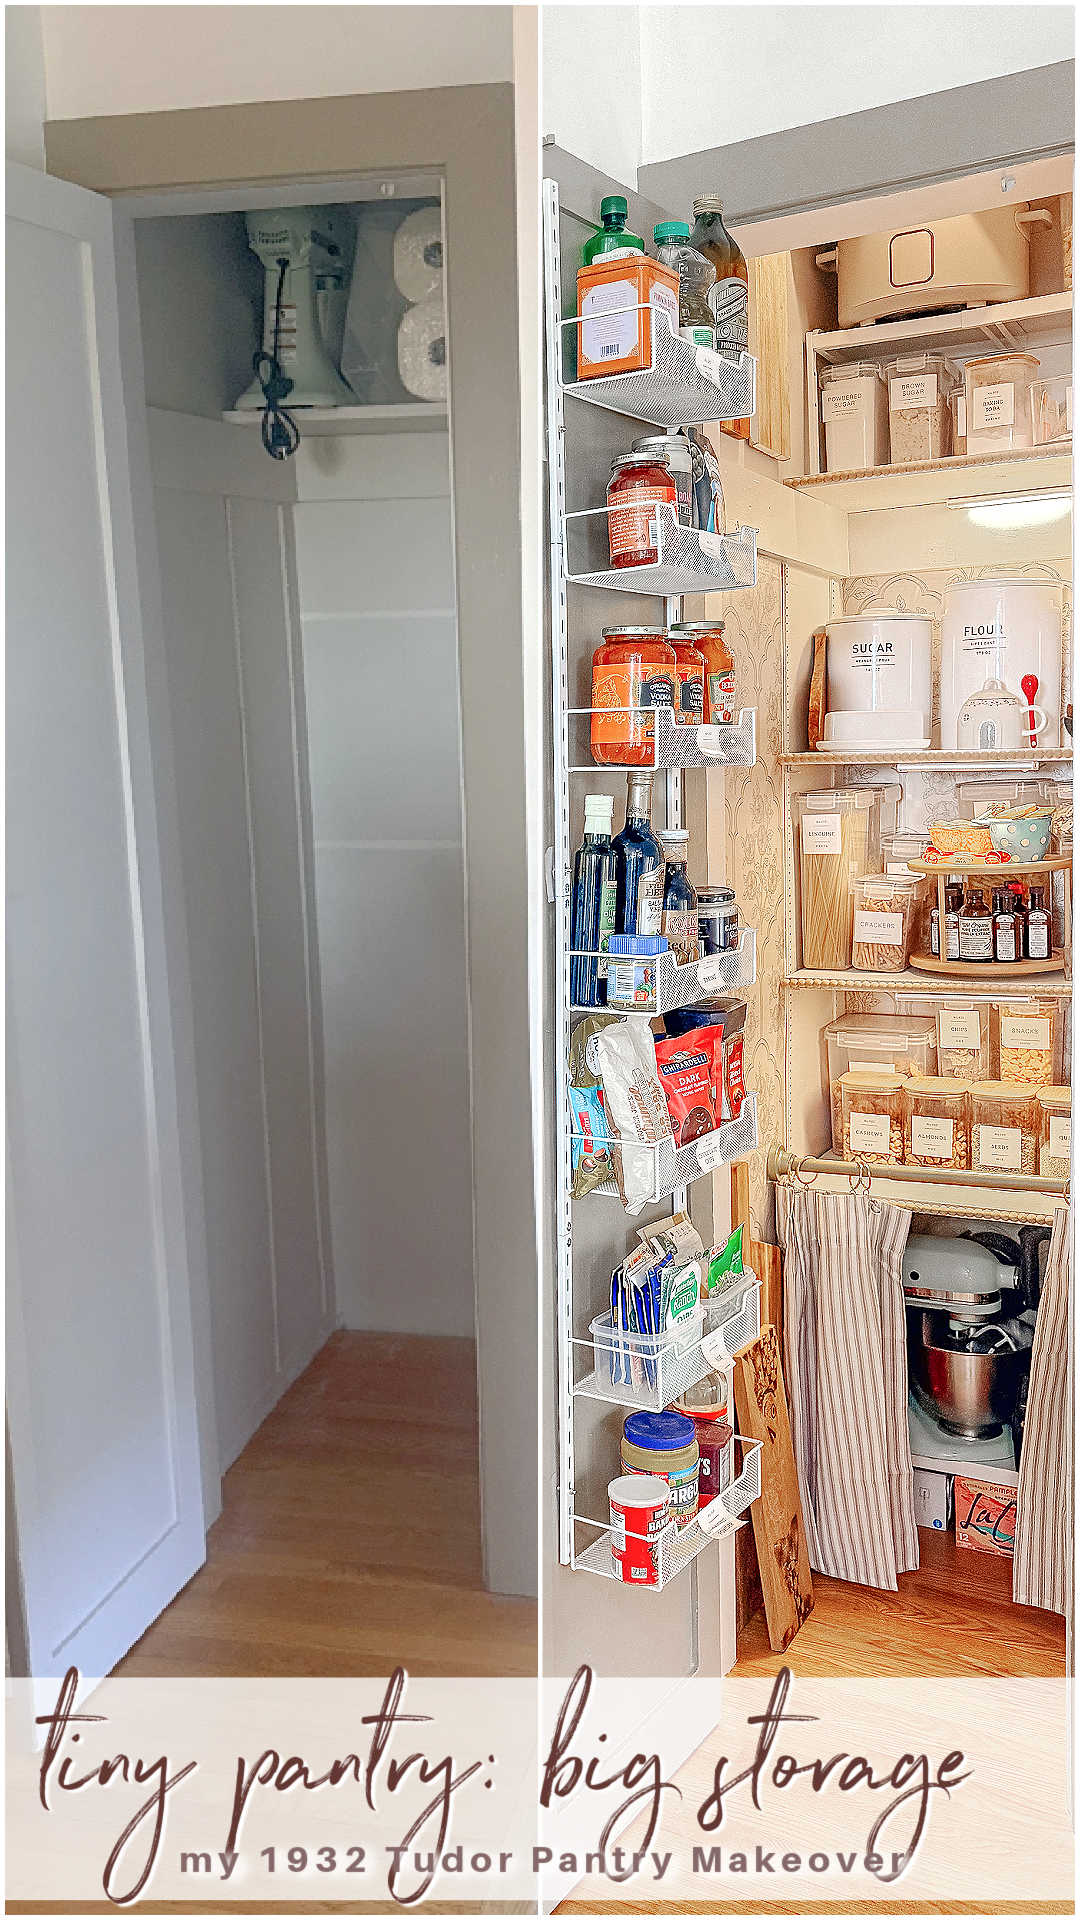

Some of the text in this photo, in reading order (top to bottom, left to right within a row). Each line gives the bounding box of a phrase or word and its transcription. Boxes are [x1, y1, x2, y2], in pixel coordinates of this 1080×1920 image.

[901, 382, 925, 390] BROWN
[902, 389, 925, 397] SUGAR
[827, 393, 863, 402] POWDERED
[833, 401, 856, 409] SUGAR
[852, 642, 893, 654] SUGAR
[650, 692, 672, 700] VODKA
[860, 921, 896, 929] CRACKERS
[1011, 1027, 1039, 1035] SNACKS
[663, 1054, 707, 1074] GHIRARDELLI
[679, 1072, 701, 1087] DARK
[855, 1129, 883, 1137] CASHEWS
[917, 1133, 947, 1141] ALMONDS
[959, 1532, 969, 1541] 12
